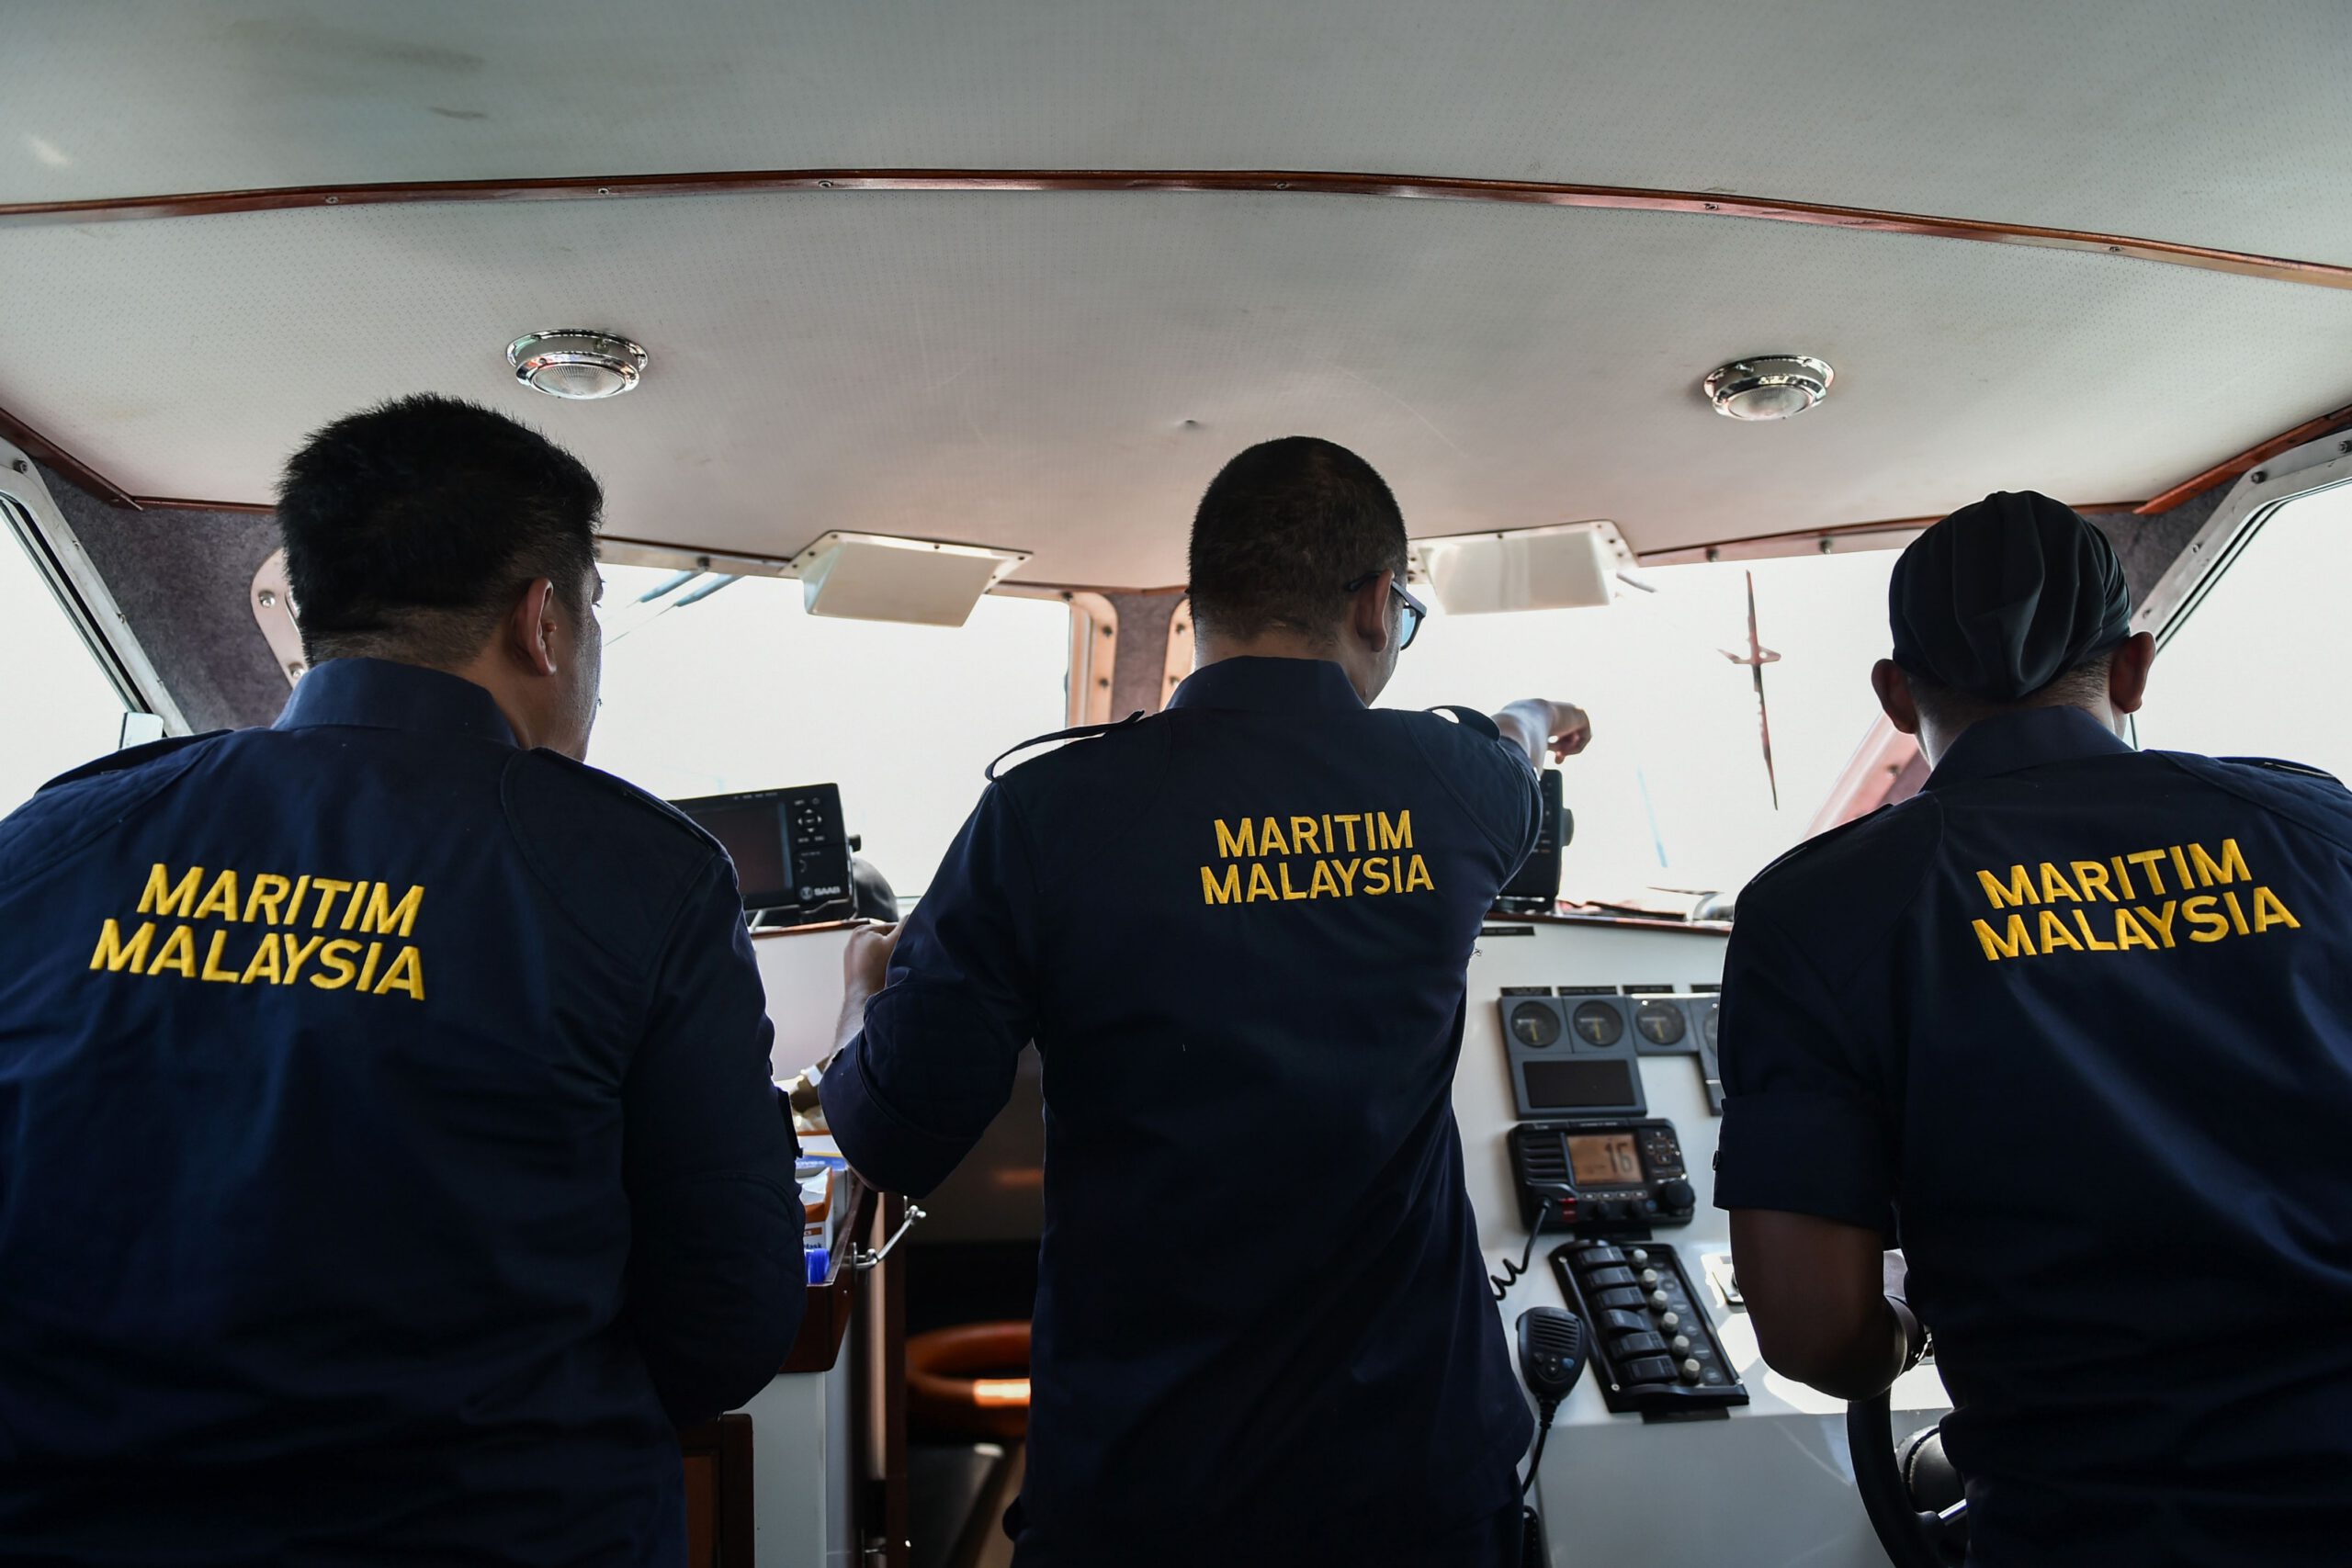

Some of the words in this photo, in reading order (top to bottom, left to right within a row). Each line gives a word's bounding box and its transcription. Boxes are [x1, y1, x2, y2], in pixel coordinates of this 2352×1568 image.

[1214, 809, 1413, 859] MARITIM
[137, 863, 425, 938] MARITIM
[814, 886, 841, 897] SAAB
[1200, 853, 1435, 905] MALAYSIA
[1975, 838, 2253, 909] MARITIM
[1972, 886, 2301, 961] MALAYSIA
[89, 918, 425, 1001] MALAYSIA
